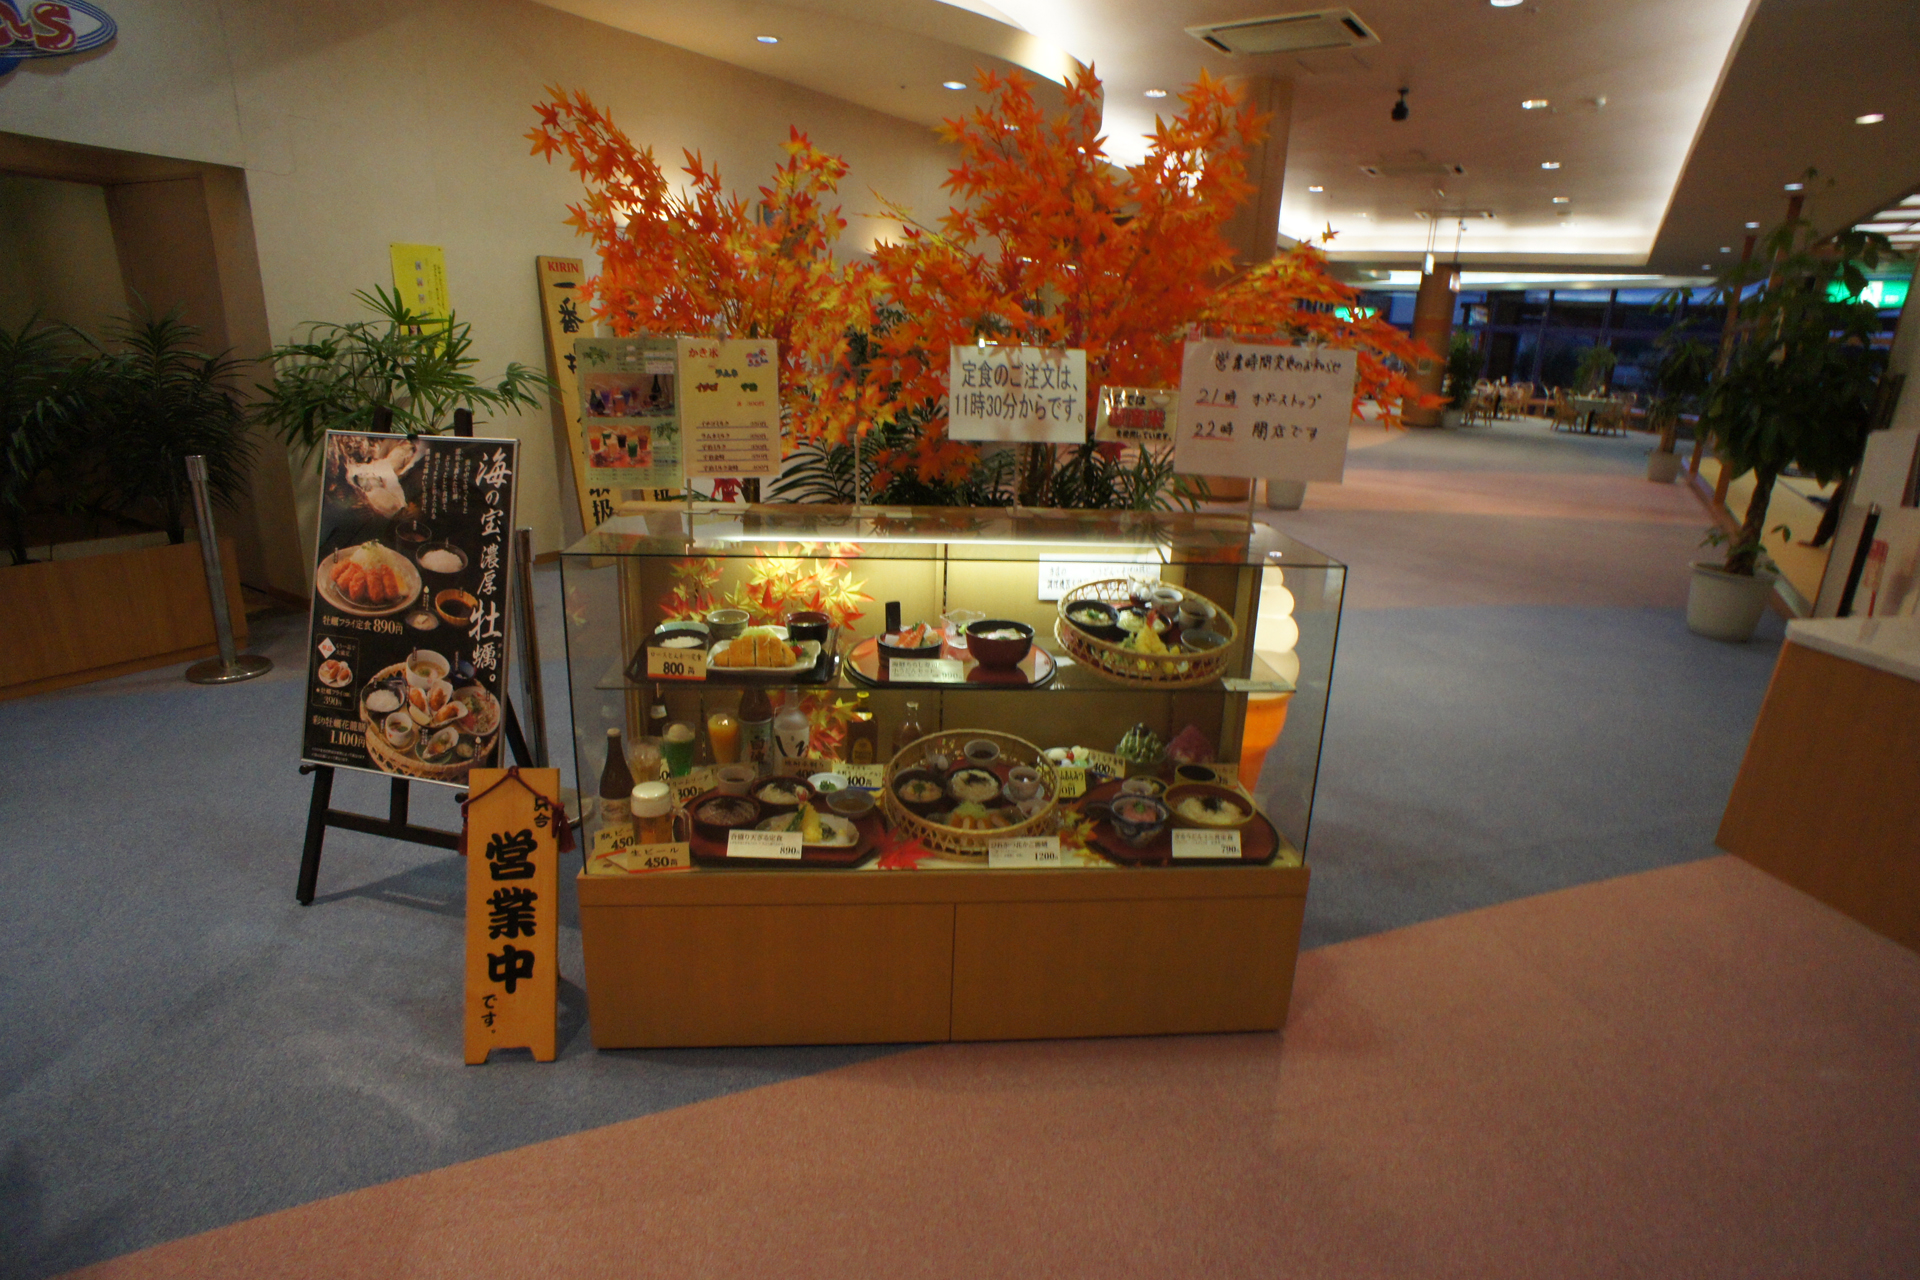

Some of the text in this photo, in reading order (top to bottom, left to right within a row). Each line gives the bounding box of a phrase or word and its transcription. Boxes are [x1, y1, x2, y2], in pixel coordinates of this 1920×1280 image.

[548, 261, 580, 273] KIRIN
[689, 348, 719, 358] かき氷
[961, 360, 1078, 391] 定食のご注文は、
[1196, 388, 1237, 405] 21時
[956, 391, 1084, 423] 11時30分からです。
[1194, 420, 1234, 438] 22時
[373, 618, 404, 635] 890円
[485, 828, 539, 994] 営業中
[481, 993, 497, 1035] です。
